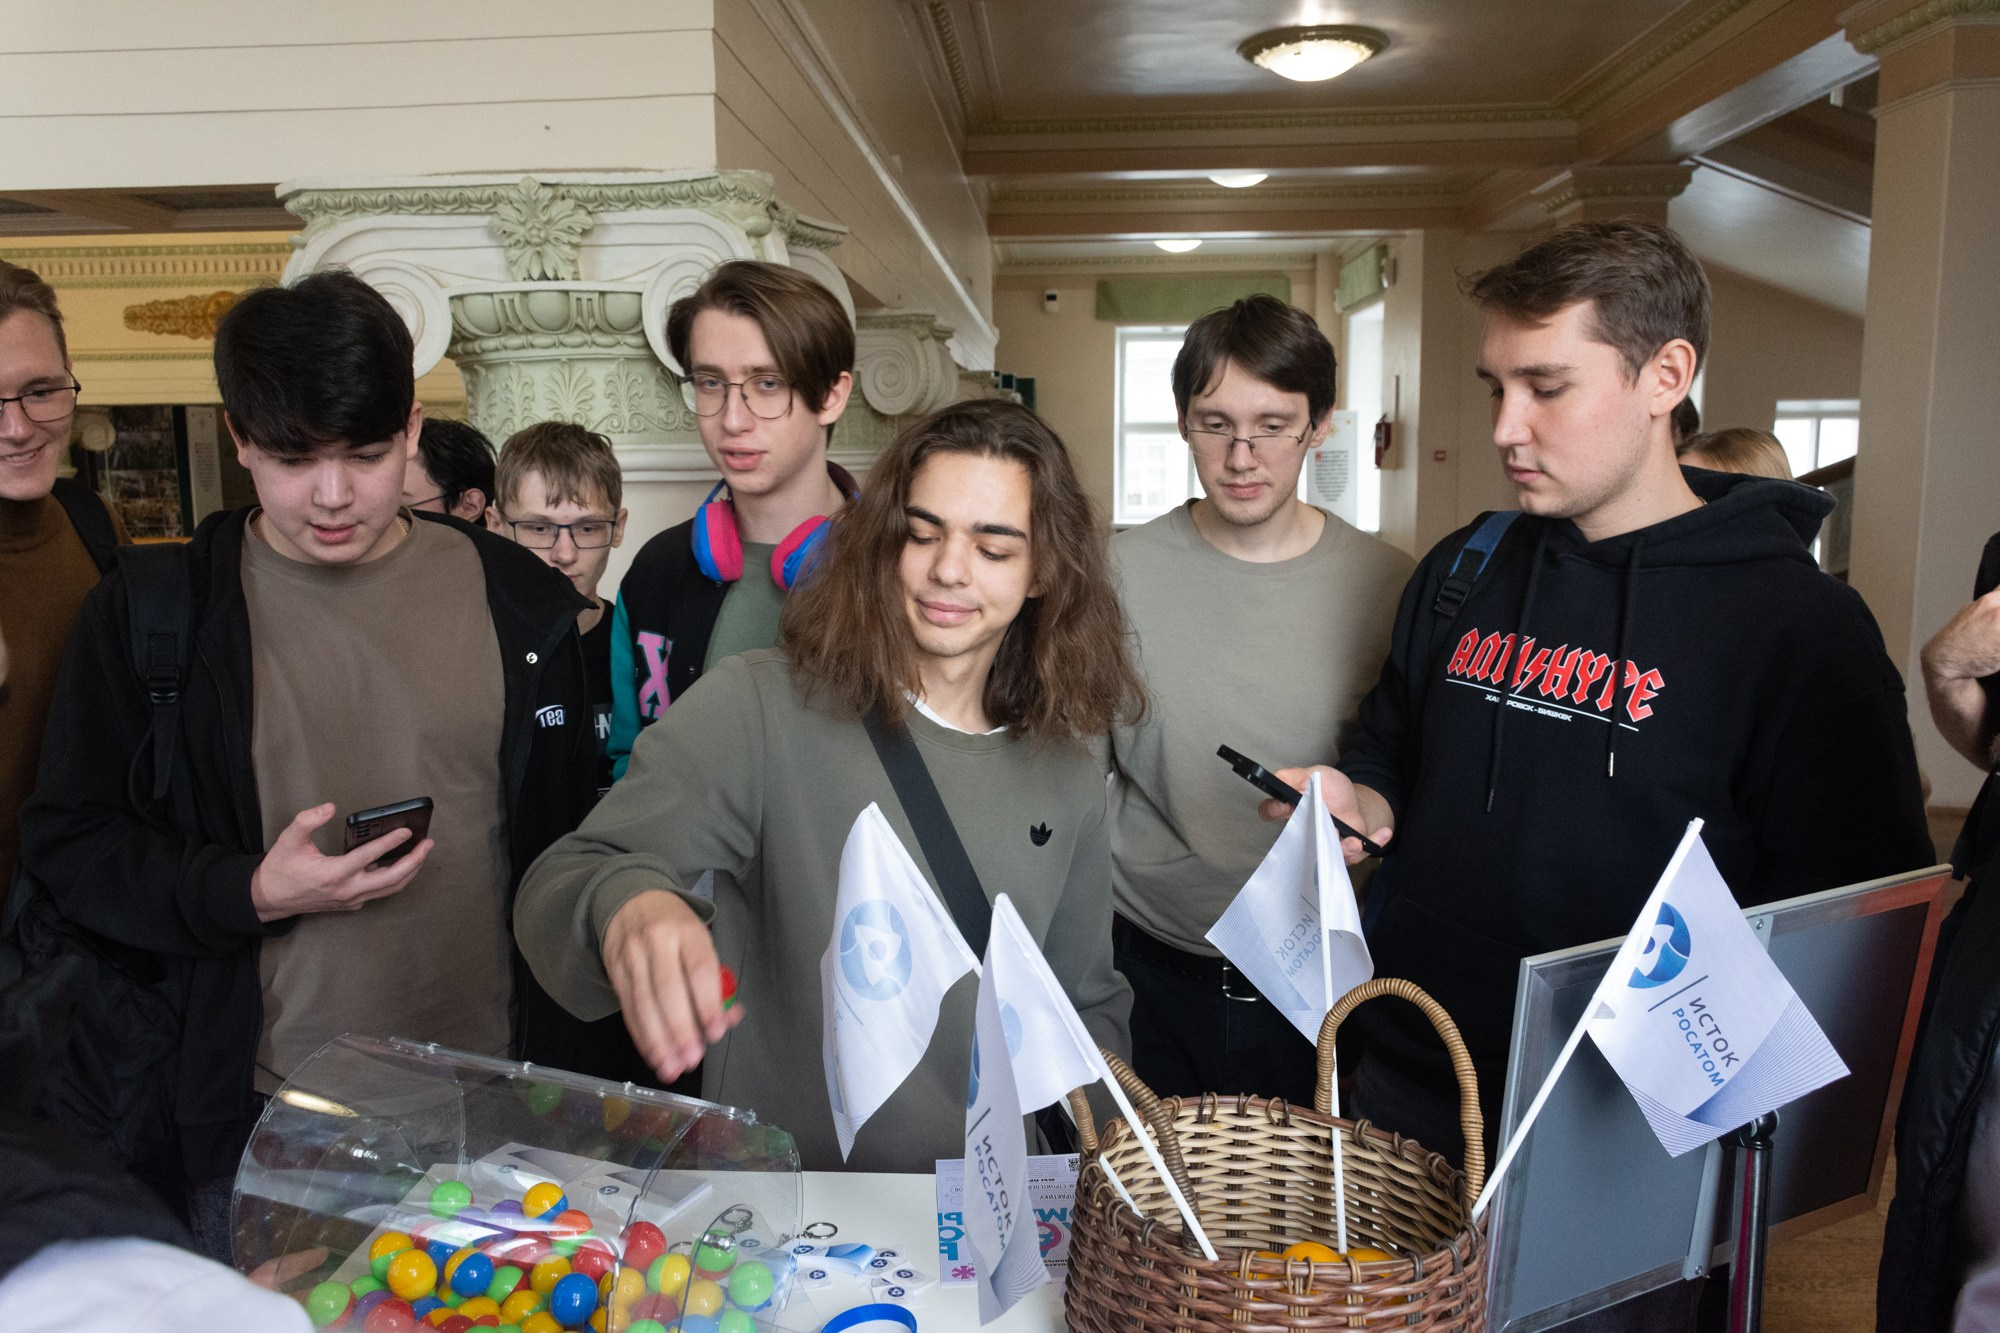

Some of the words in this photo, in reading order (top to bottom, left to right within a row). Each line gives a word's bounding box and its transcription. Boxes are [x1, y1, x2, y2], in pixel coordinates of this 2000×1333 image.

[1672, 1007, 1725, 1088] РОСАТОМ
[1689, 997, 1740, 1067] ИСТОК
[975, 1144, 1006, 1250] РОСАТОМ
[982, 1135, 1012, 1232] ИСТОК
